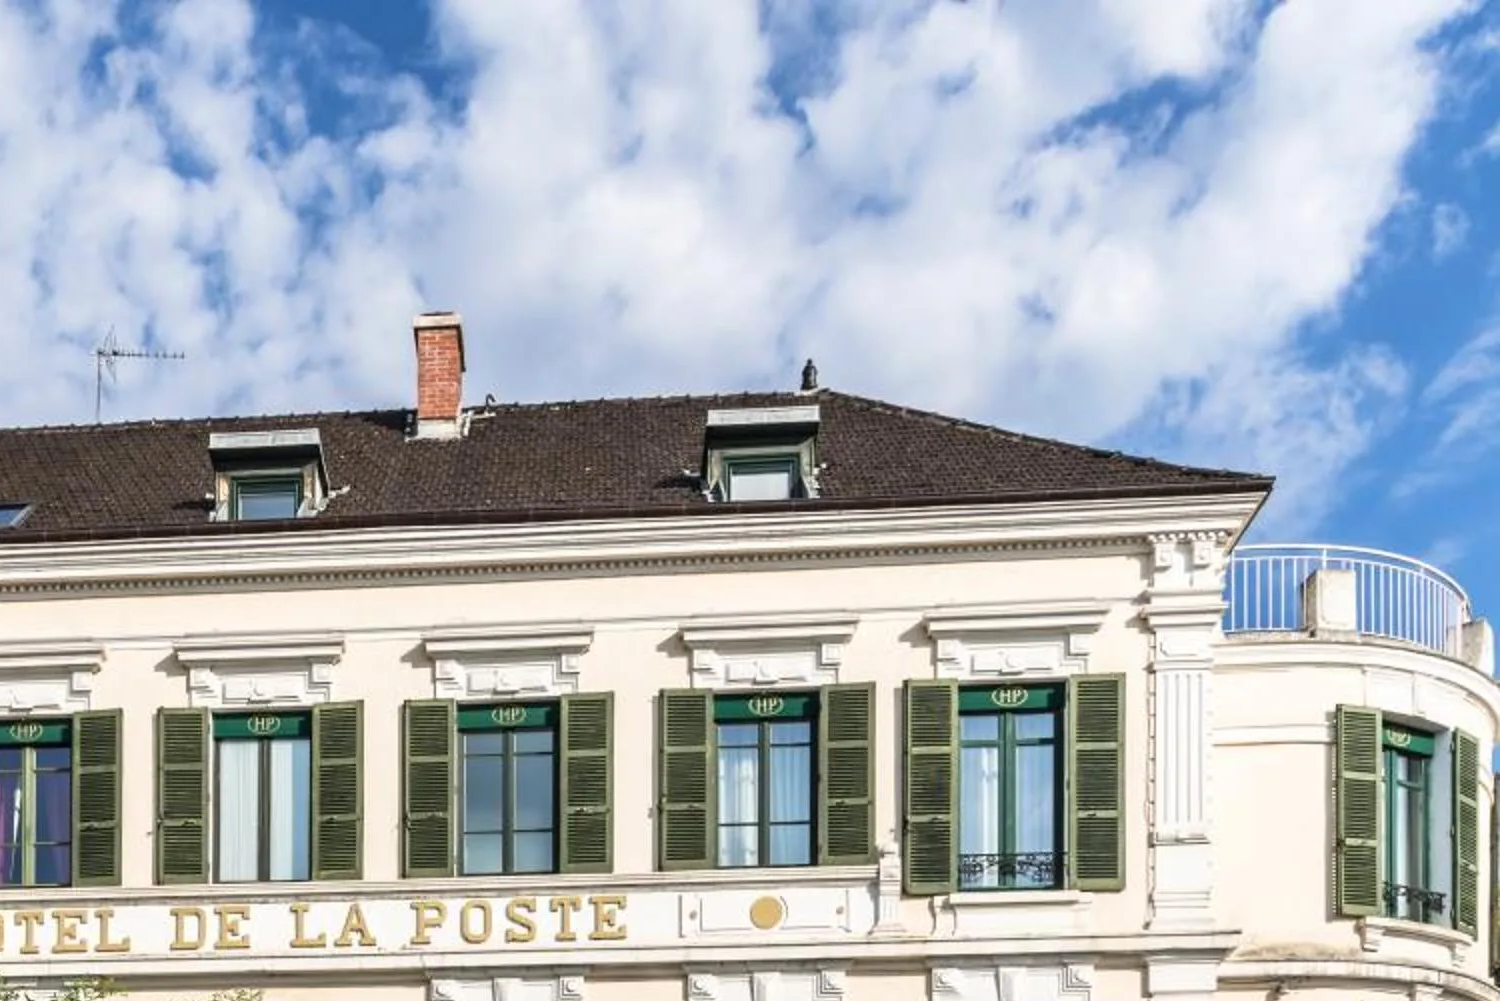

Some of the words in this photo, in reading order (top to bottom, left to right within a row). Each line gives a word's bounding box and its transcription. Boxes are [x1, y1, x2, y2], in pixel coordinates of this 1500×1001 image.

[998, 688, 1021, 703] HP
[756, 697, 778, 713] HP
[255, 716, 276, 731] HP
[169, 904, 251, 951] DE
[289, 902, 378, 948] LA
[410, 894, 628, 945] POSTE
